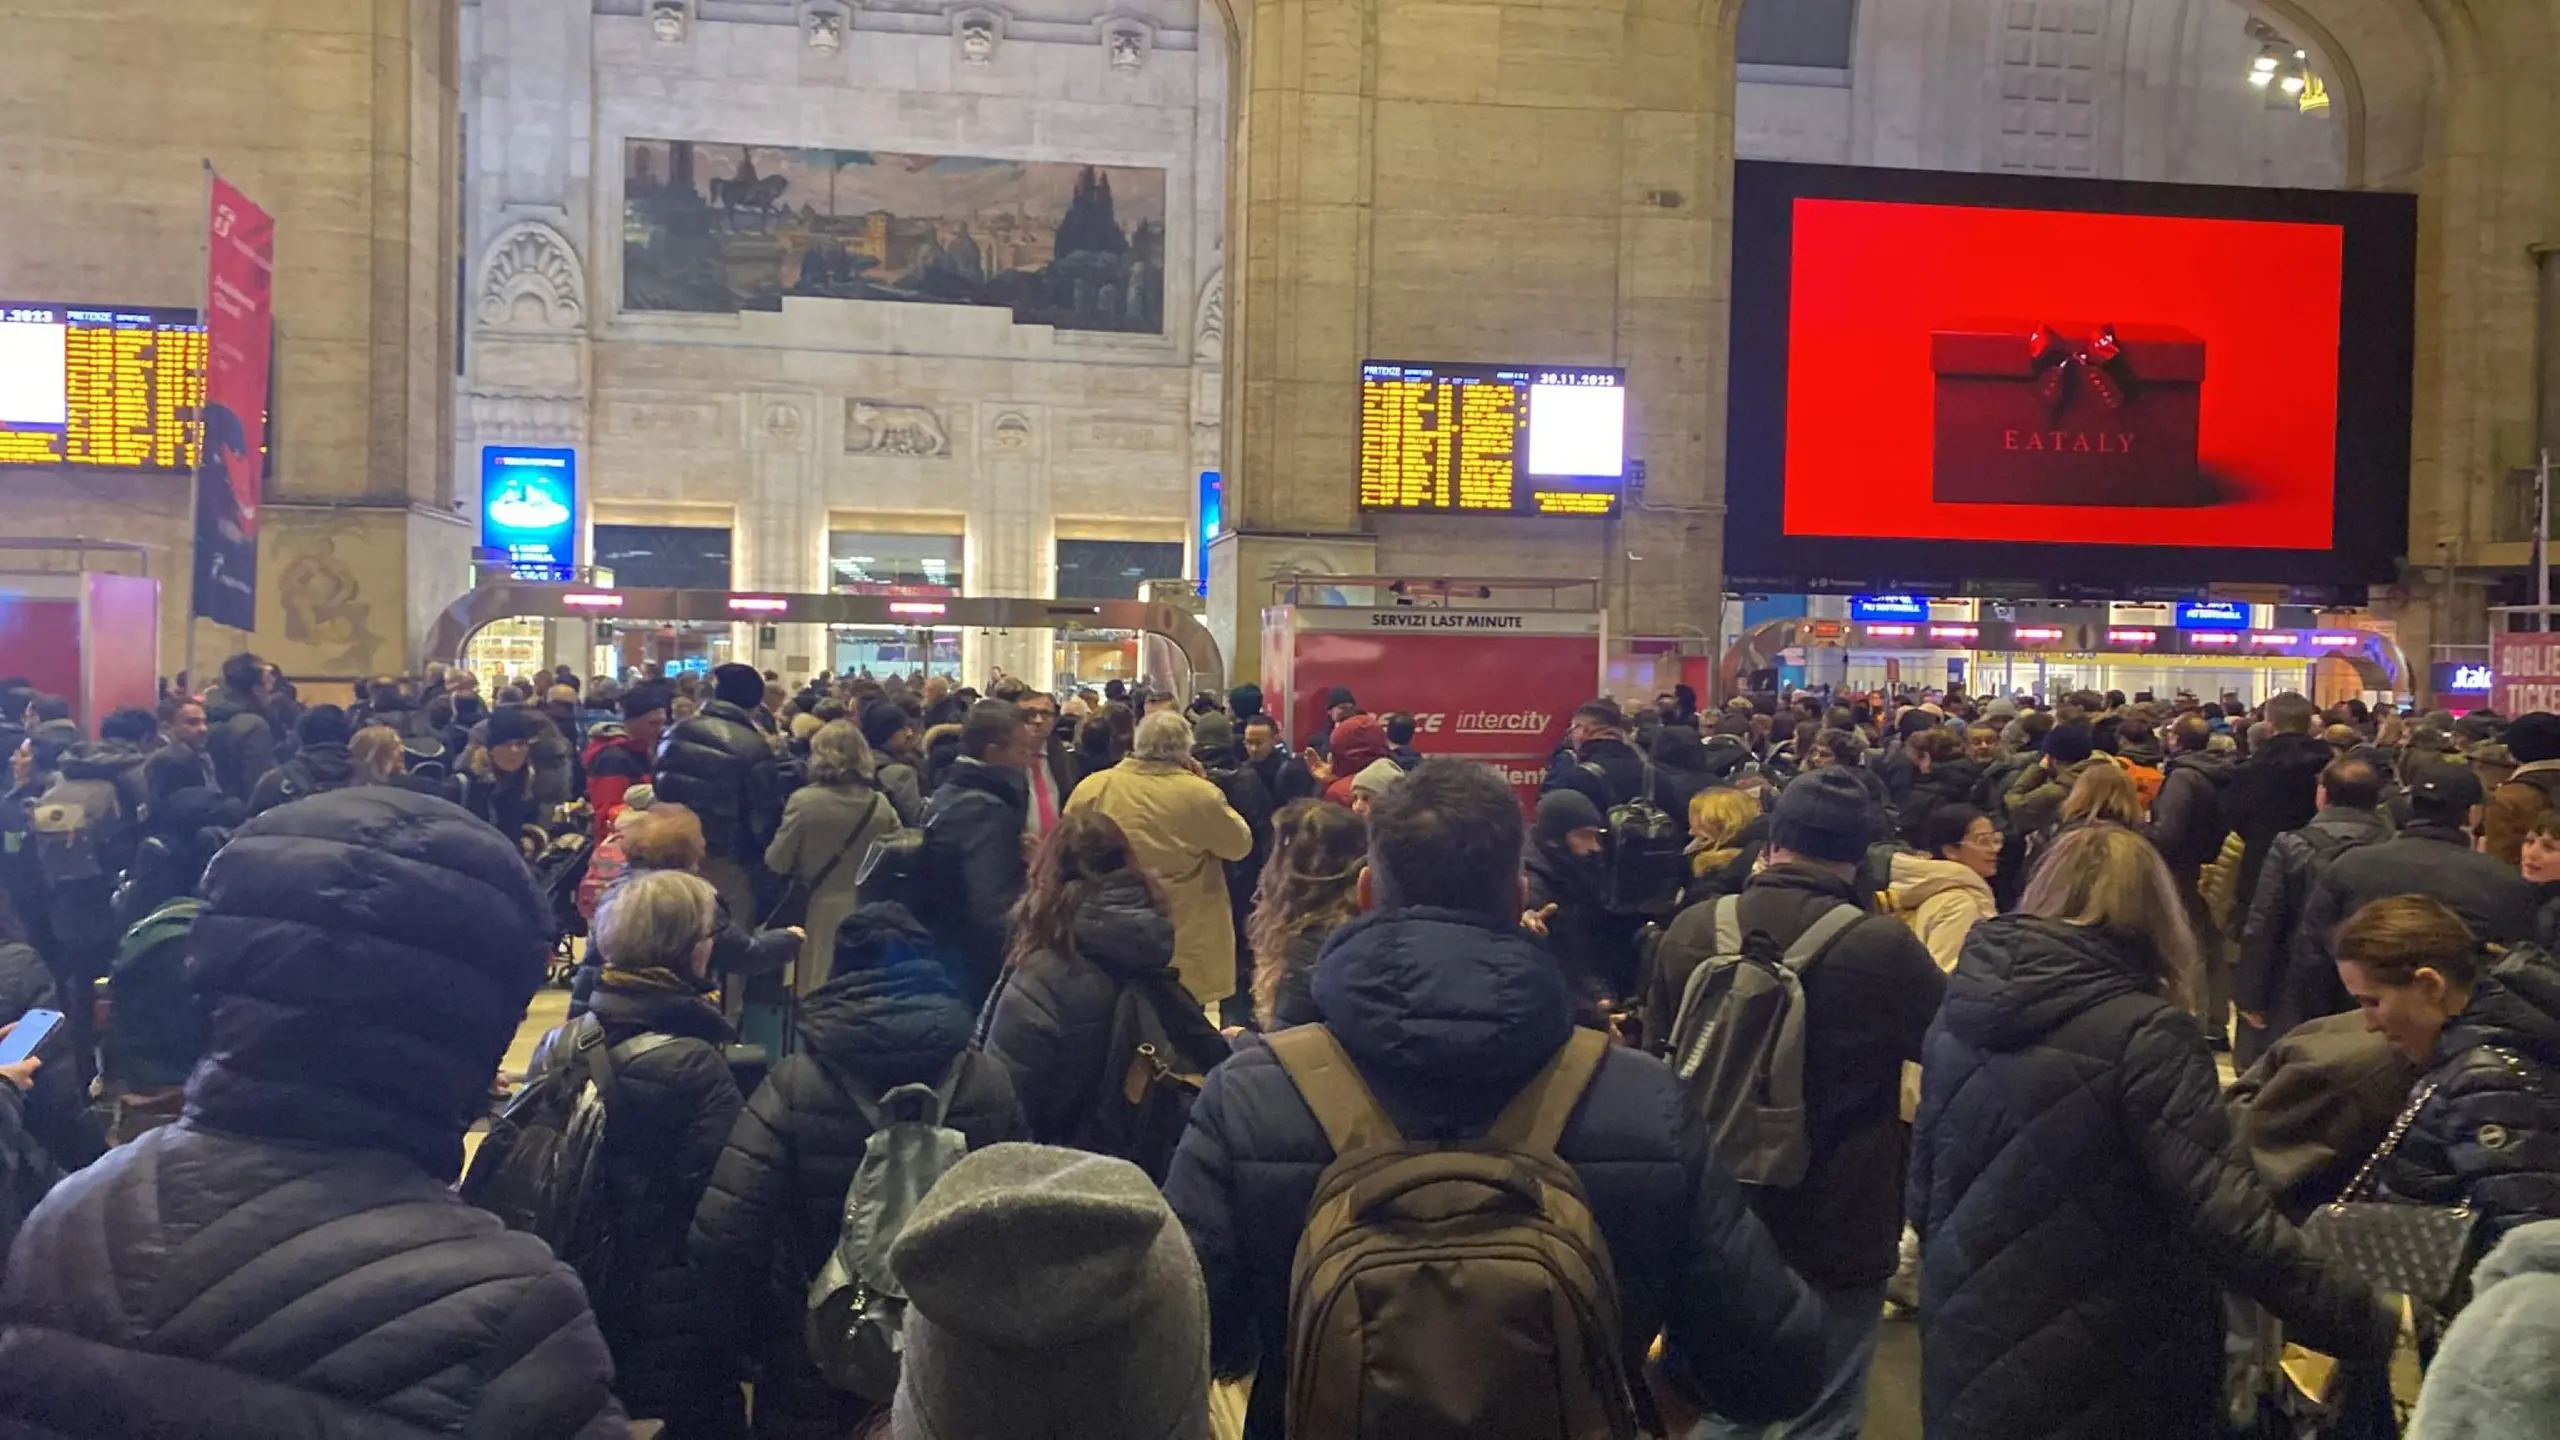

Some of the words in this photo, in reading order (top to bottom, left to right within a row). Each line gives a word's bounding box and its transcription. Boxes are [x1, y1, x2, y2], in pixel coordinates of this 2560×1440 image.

[1540, 373, 1614, 386] 30.11.2023
[2003, 429, 2135, 452] EATALY
[1372, 614, 1426, 626] SERVIZI
[1431, 615, 1463, 627] LAST
[1466, 616, 1522, 628] MINUTE
[1456, 710, 1551, 734] intercity
